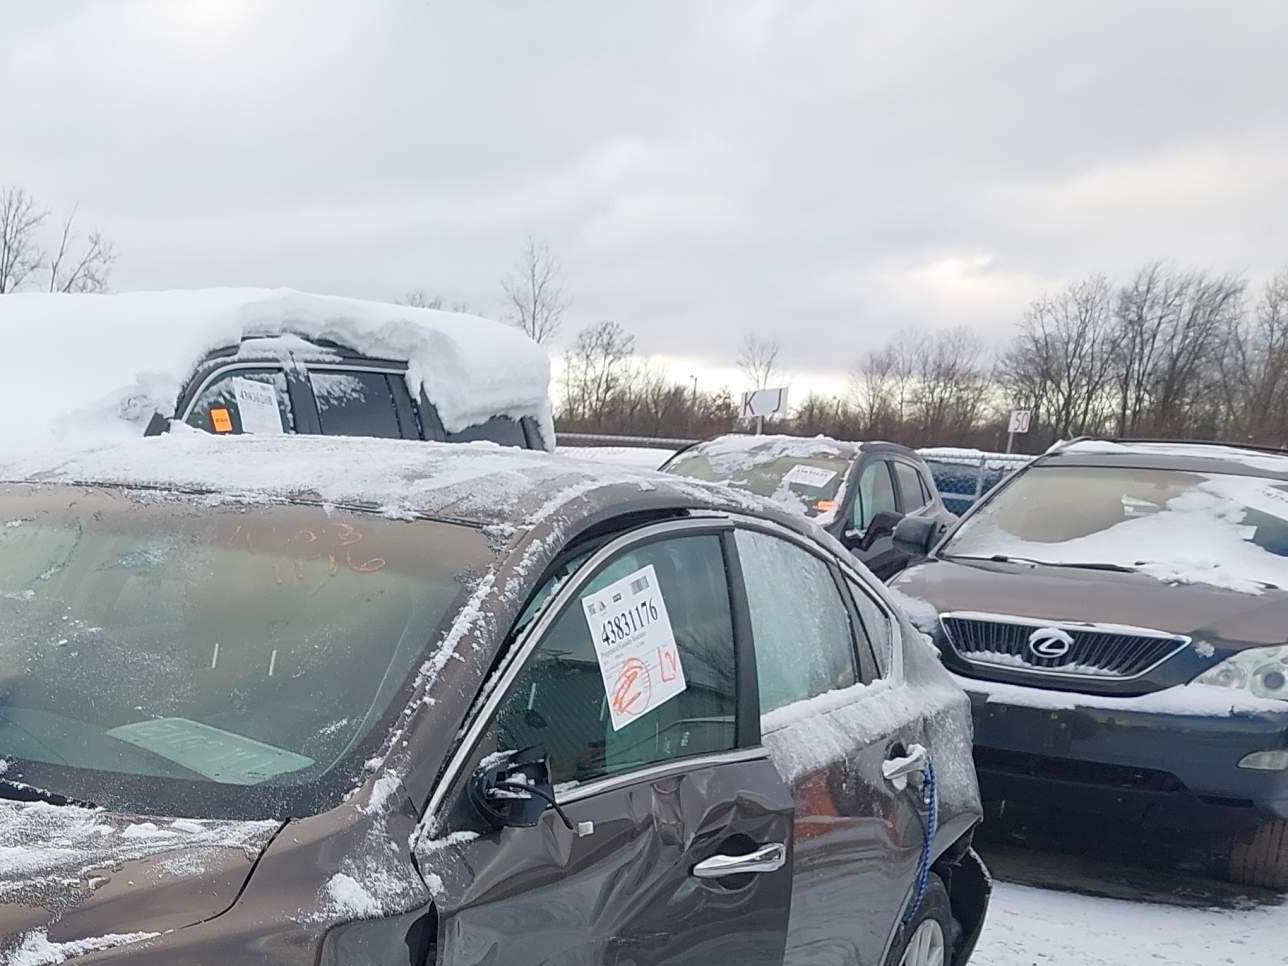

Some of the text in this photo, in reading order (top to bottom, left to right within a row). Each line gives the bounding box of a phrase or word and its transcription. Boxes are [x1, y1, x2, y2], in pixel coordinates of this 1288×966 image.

[743, 388, 782, 416] K J
[1014, 412, 1029, 431] 50
[602, 598, 658, 646] 43831176
